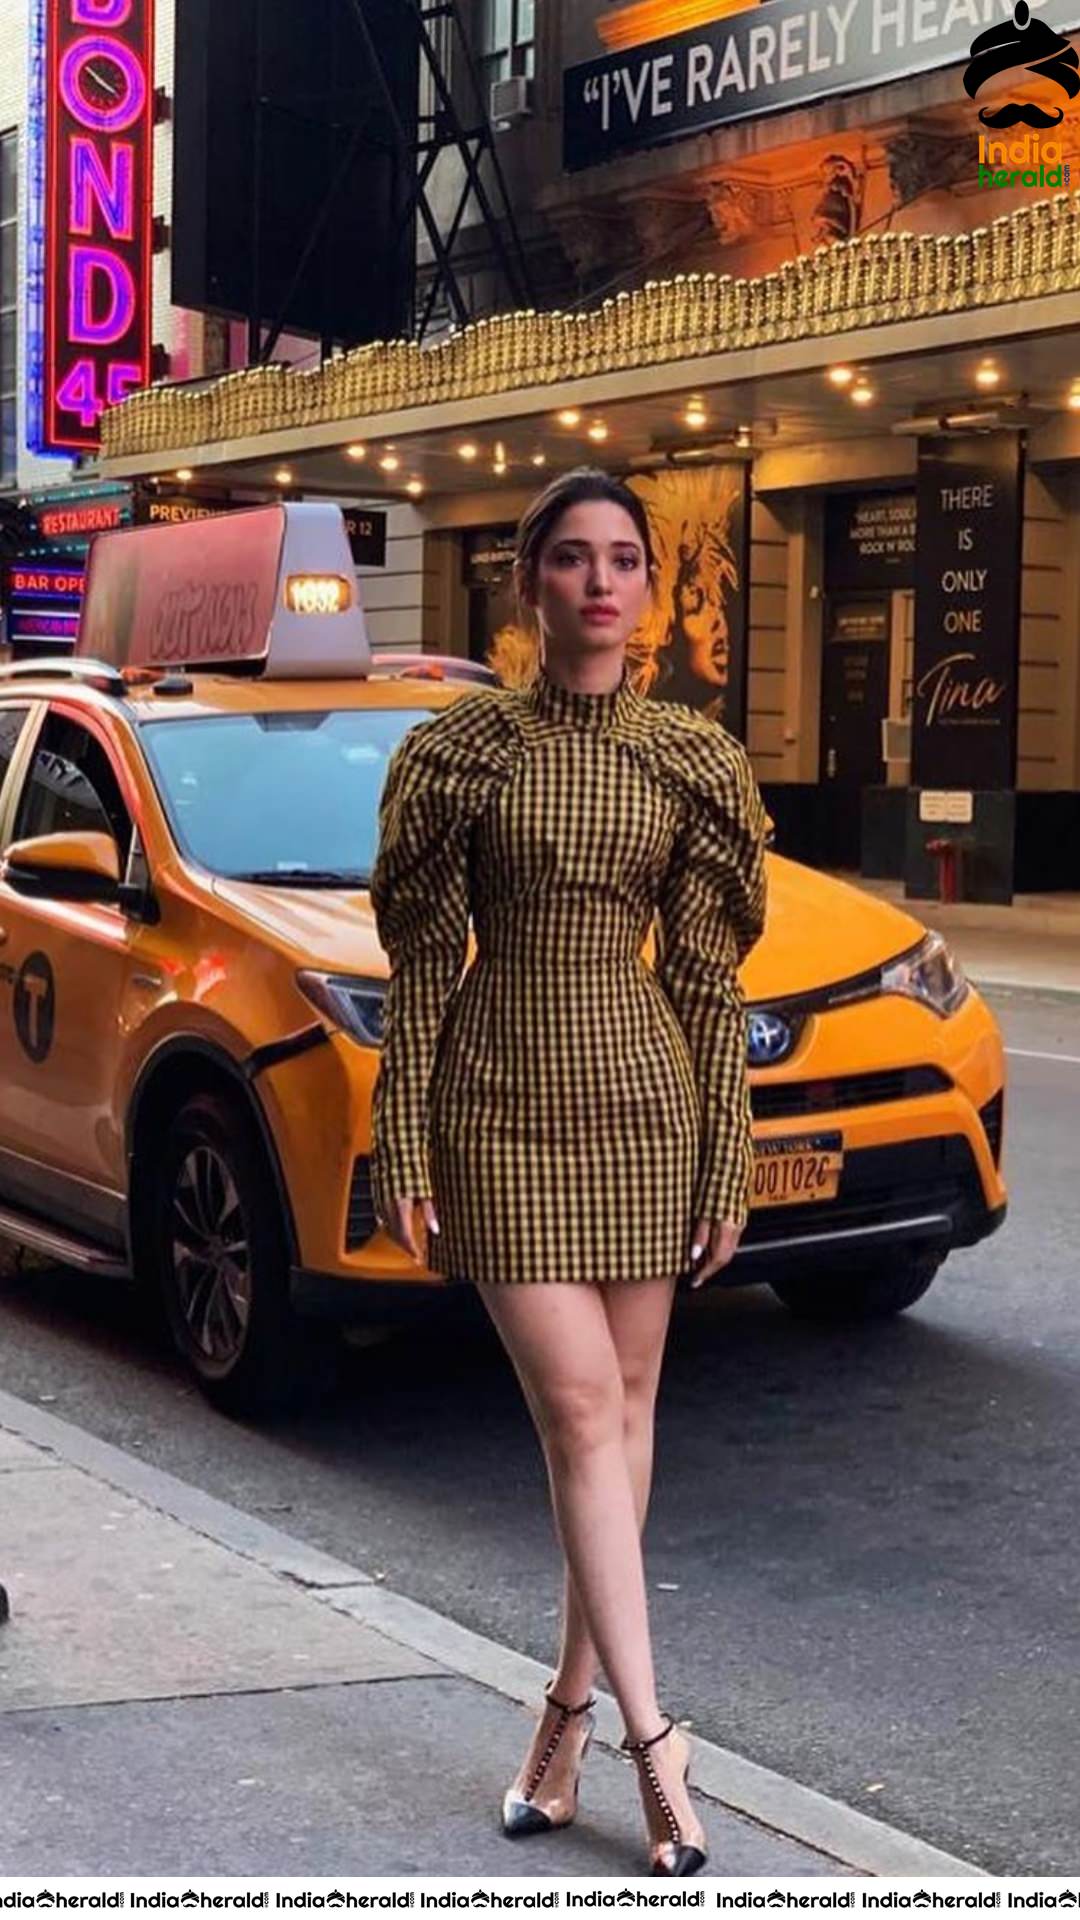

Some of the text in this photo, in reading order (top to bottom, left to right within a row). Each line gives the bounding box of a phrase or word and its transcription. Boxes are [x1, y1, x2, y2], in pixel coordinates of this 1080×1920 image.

[686, 2, 858, 107] RARELY
[60, 0, 145, 345] OND
[940, 484, 993, 511] THERE
[42, 505, 119, 536] RESTAURANT
[359, 521, 373, 537] 12
[958, 528, 973, 550] IS
[14, 573, 49, 591] BAR
[942, 569, 987, 592] ONLY
[944, 610, 983, 634] ONE
[917, 653, 1005, 727] Tina
[24, 974, 48, 1048] T
